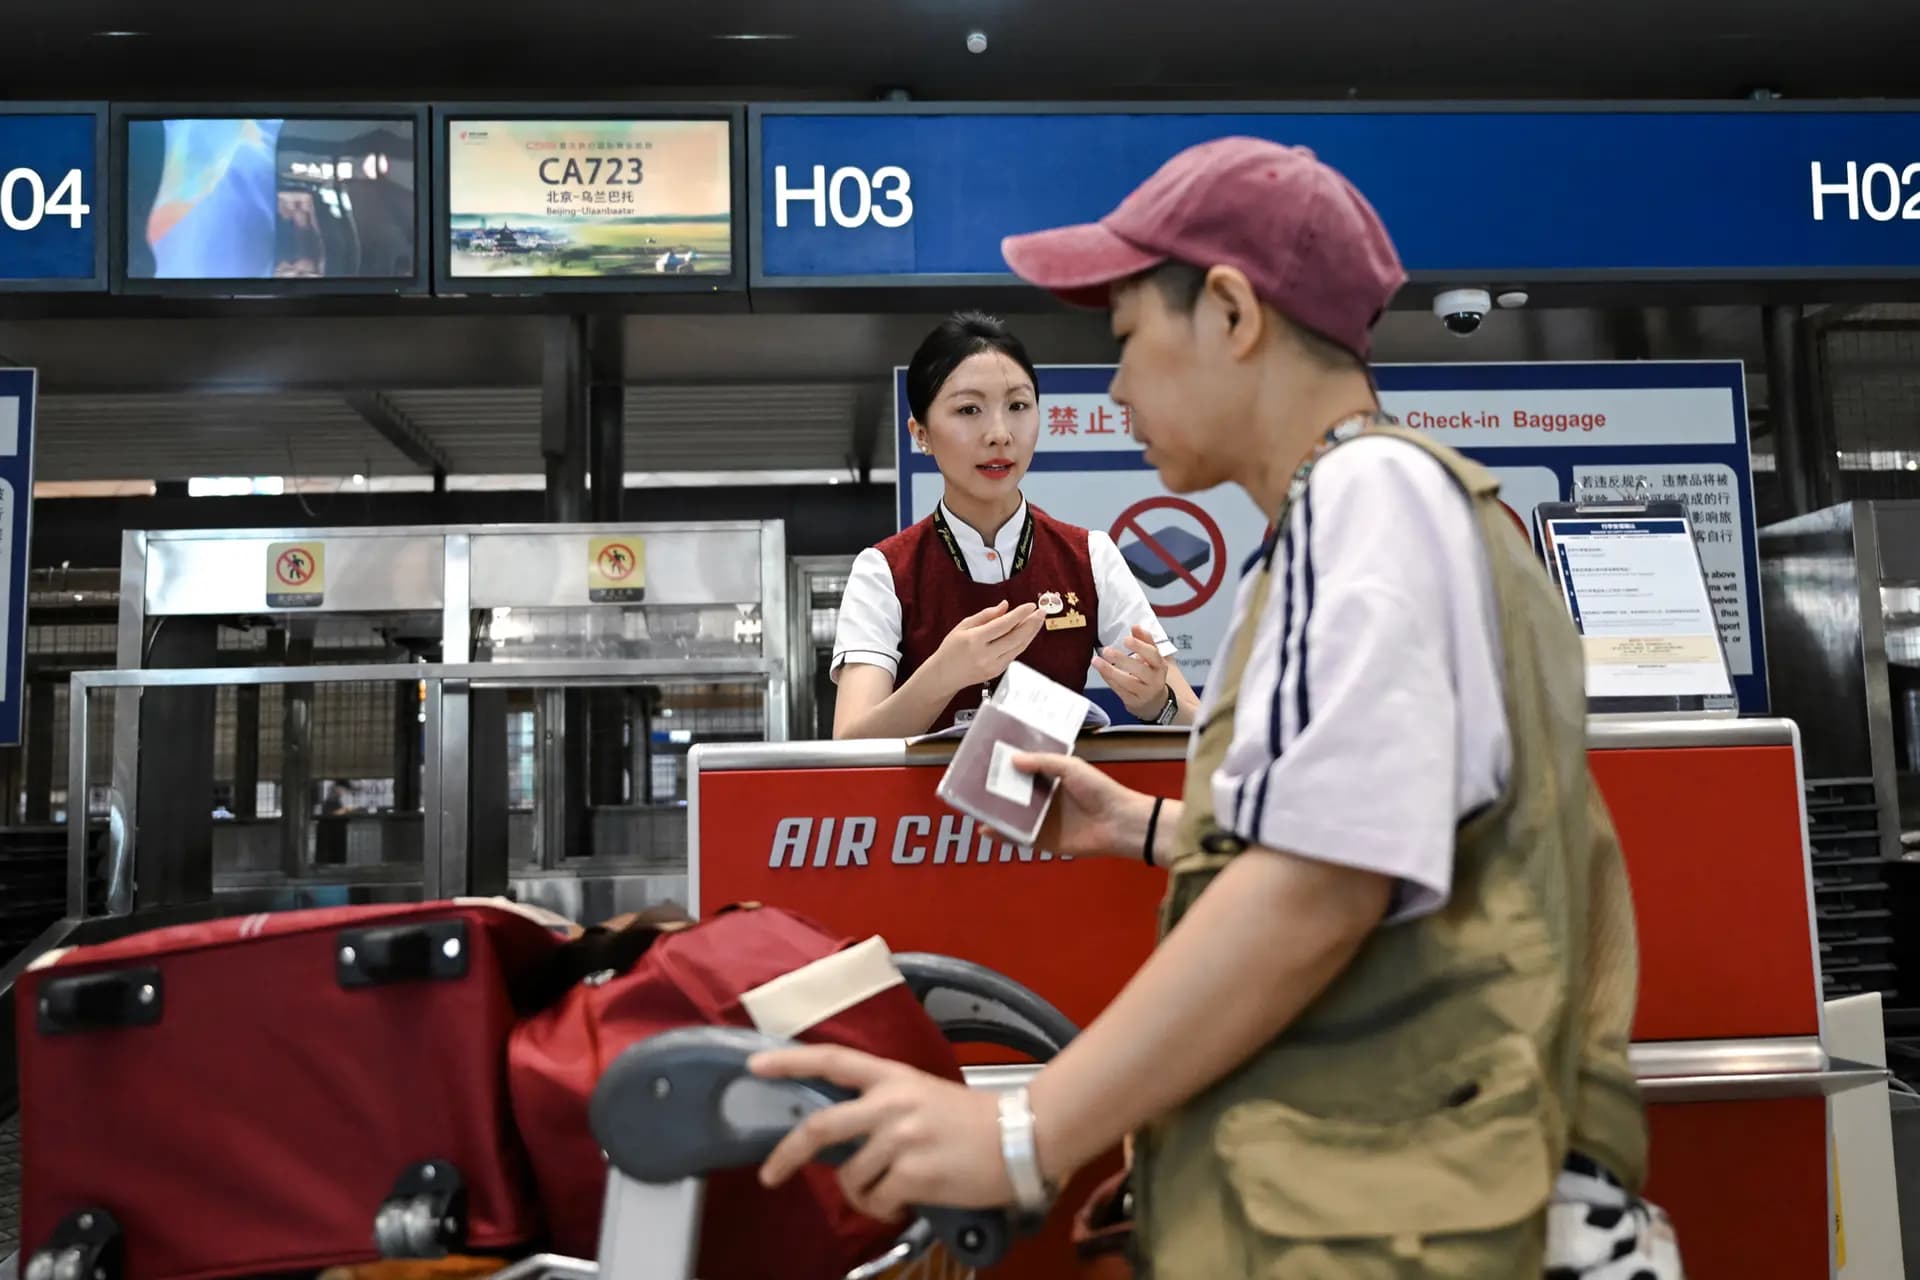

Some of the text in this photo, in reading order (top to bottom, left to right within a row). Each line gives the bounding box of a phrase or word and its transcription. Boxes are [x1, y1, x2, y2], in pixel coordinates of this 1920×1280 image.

[538, 157, 644, 186] CA723
[0, 167, 91, 231] 04
[546, 190, 635, 204] 北京-乌兰巴托
[775, 164, 914, 228] H03
[1407, 410, 1500, 429] Check-in
[1512, 410, 1607, 432] Baggage
[1711, 570, 1736, 579] above
[1724, 582, 1737, 592] will
[1720, 608, 1739, 617] thus
[767, 814, 1074, 869] AIR CHI
